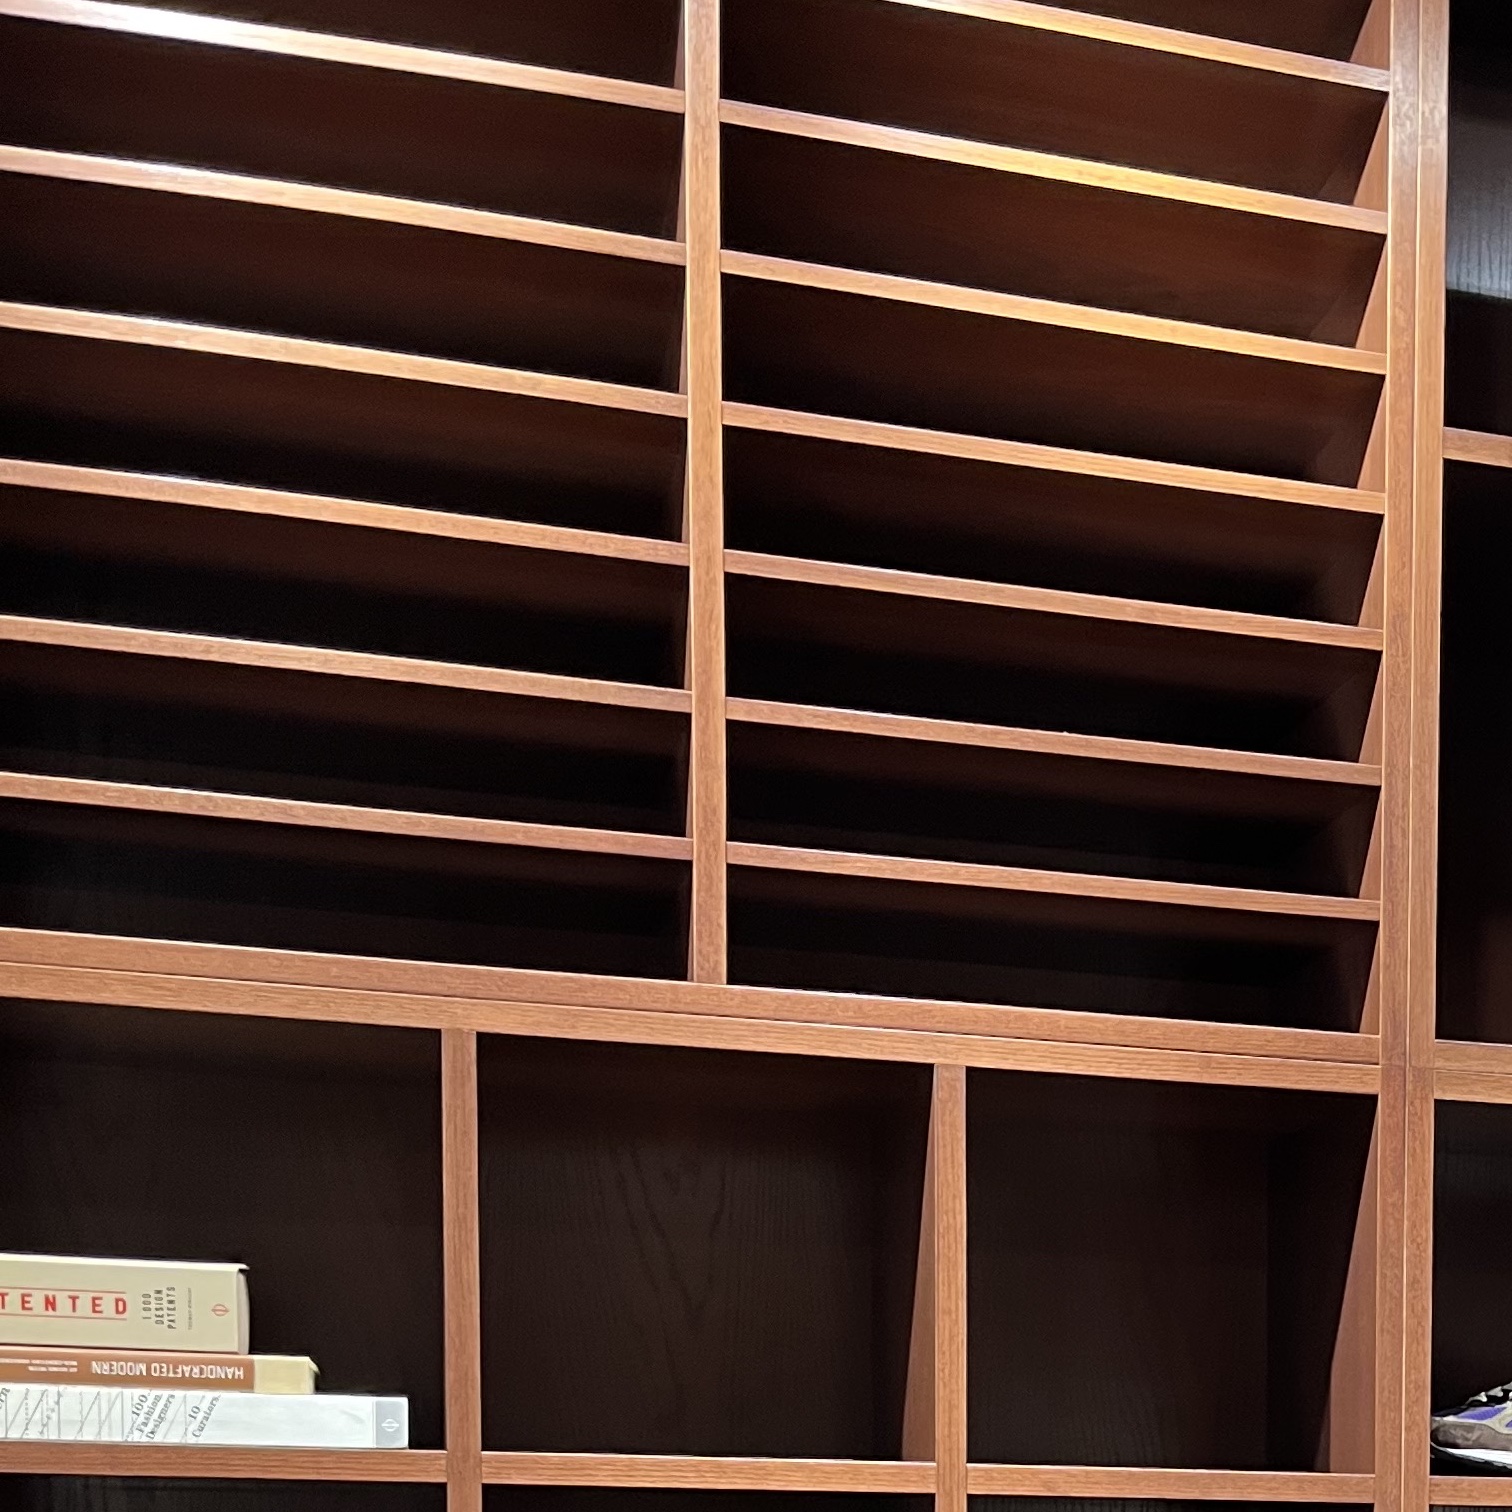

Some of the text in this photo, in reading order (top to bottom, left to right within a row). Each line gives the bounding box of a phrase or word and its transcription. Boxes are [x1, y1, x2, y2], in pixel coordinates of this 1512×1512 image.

[0, 1292, 127, 1315] TENTED
[153, 1289, 165, 1325] DESIGN
[166, 1286, 177, 1329] PATENTS
[91, 1360, 147, 1376] MODERN
[151, 1362, 244, 1380] HANDCRAFTED
[131, 1394, 148, 1417] 100
[135, 1394, 162, 1434] Fashion
[145, 1393, 175, 1440] Designers
[187, 1405, 201, 1420] 10
[191, 1395, 219, 1438] Curators
